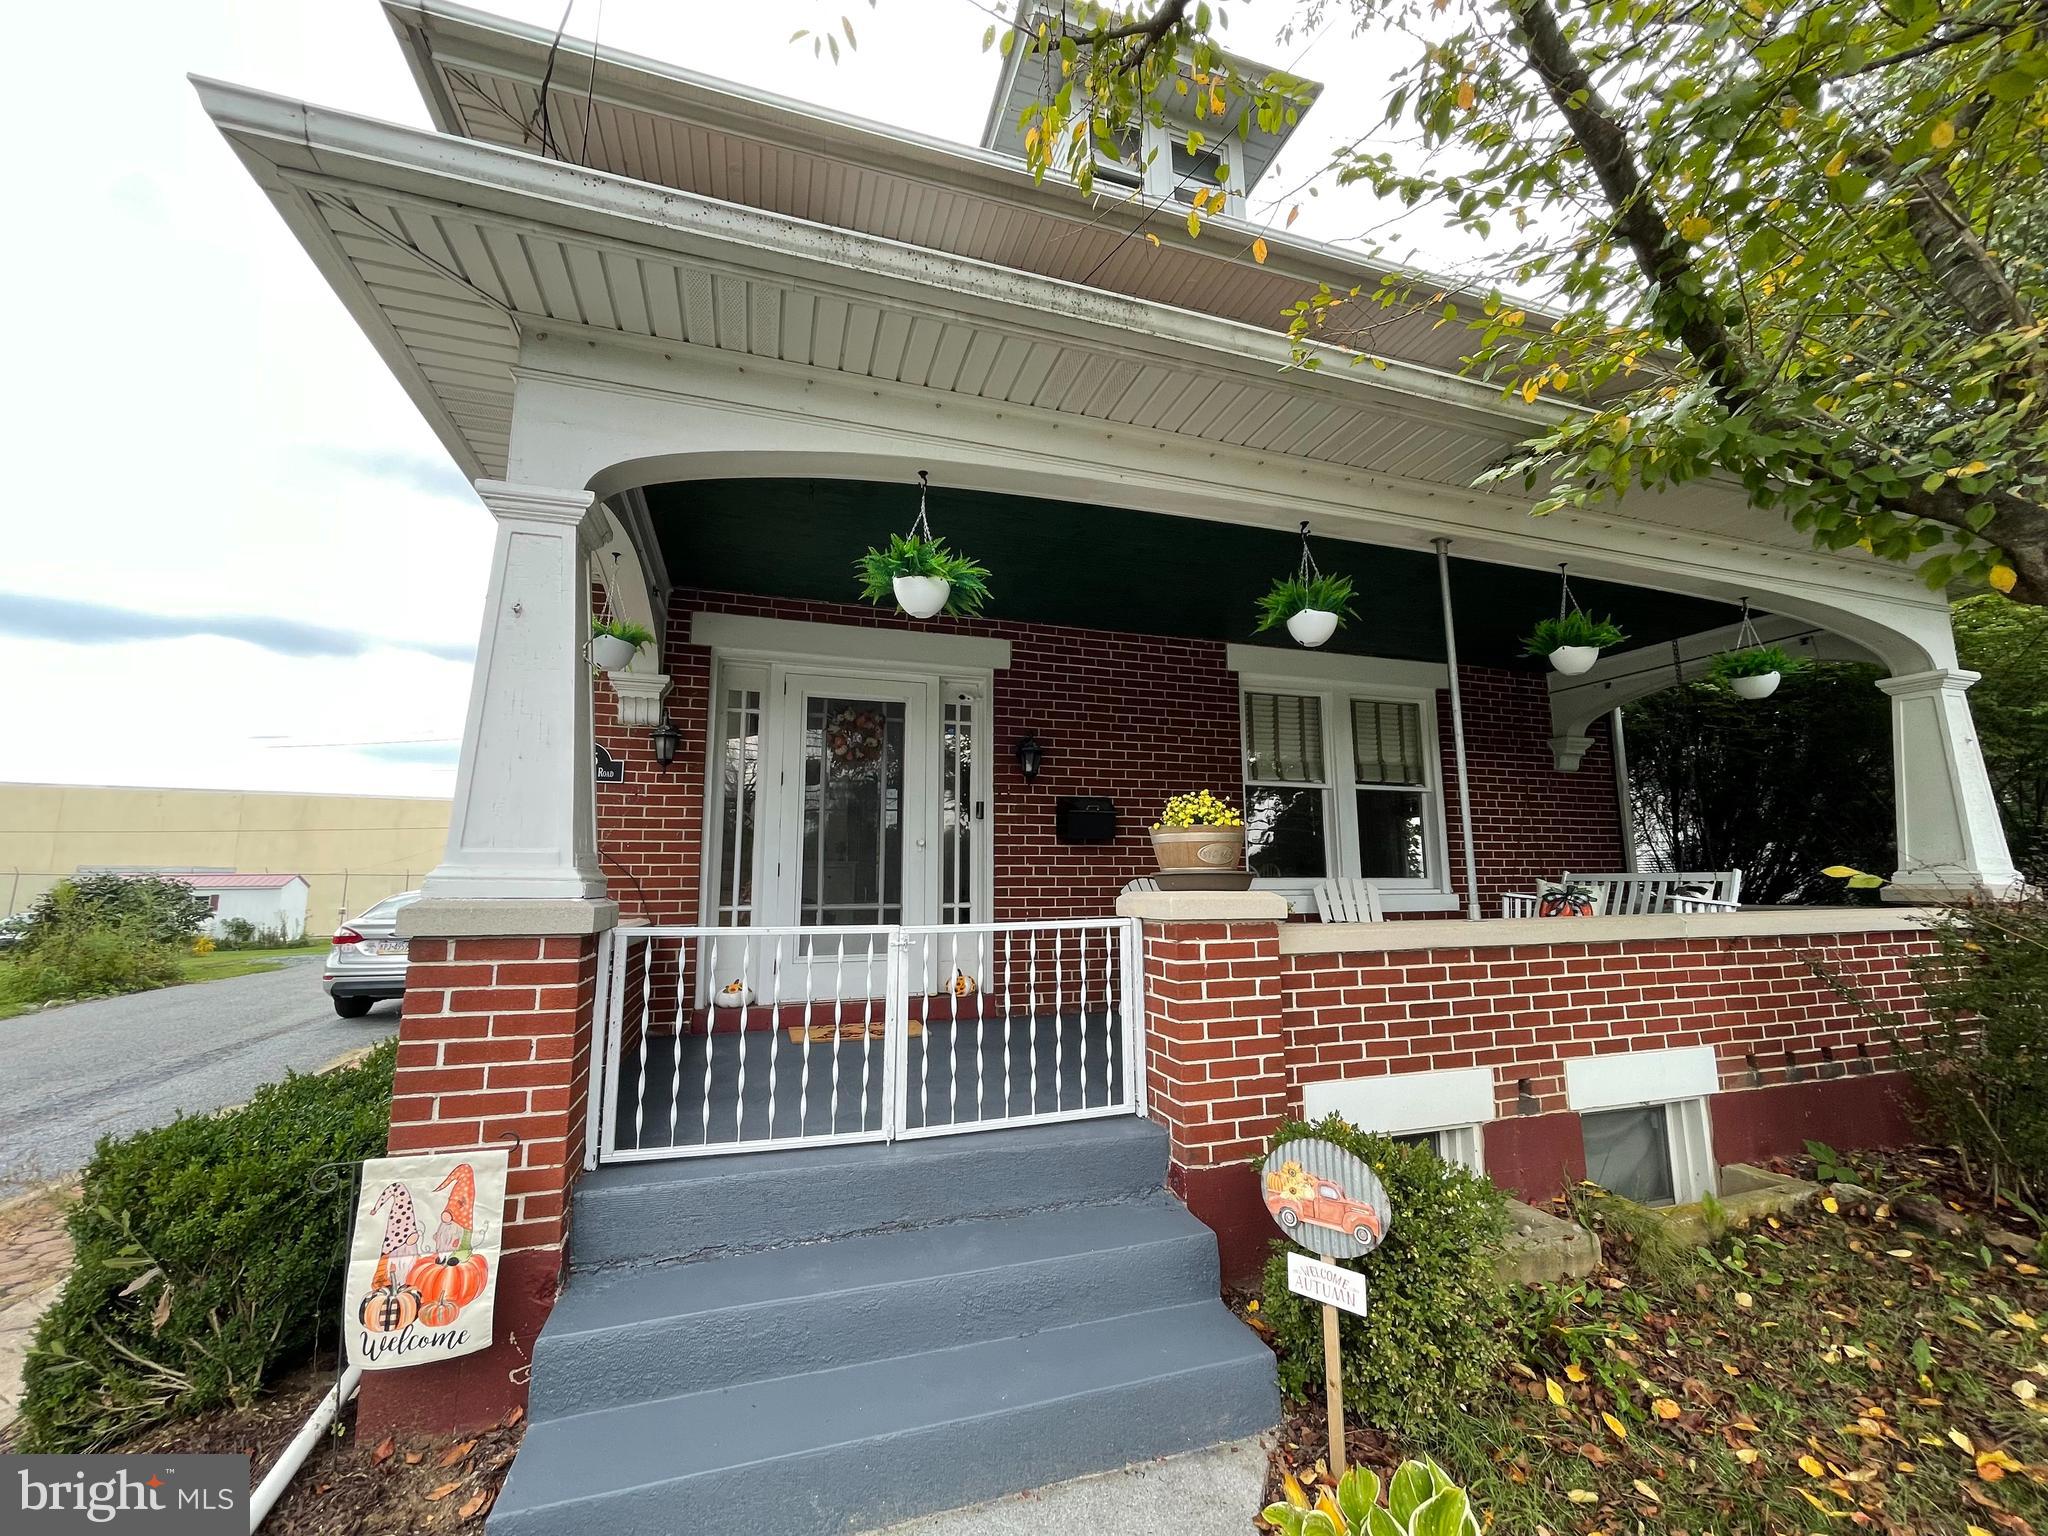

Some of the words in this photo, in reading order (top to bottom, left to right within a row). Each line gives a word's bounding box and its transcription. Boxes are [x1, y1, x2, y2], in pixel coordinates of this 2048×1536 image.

[1295, 1275, 1355, 1306] AUTUMN
[1300, 1265, 1349, 1290] WELCOME
[359, 1323, 471, 1361] Welcome
